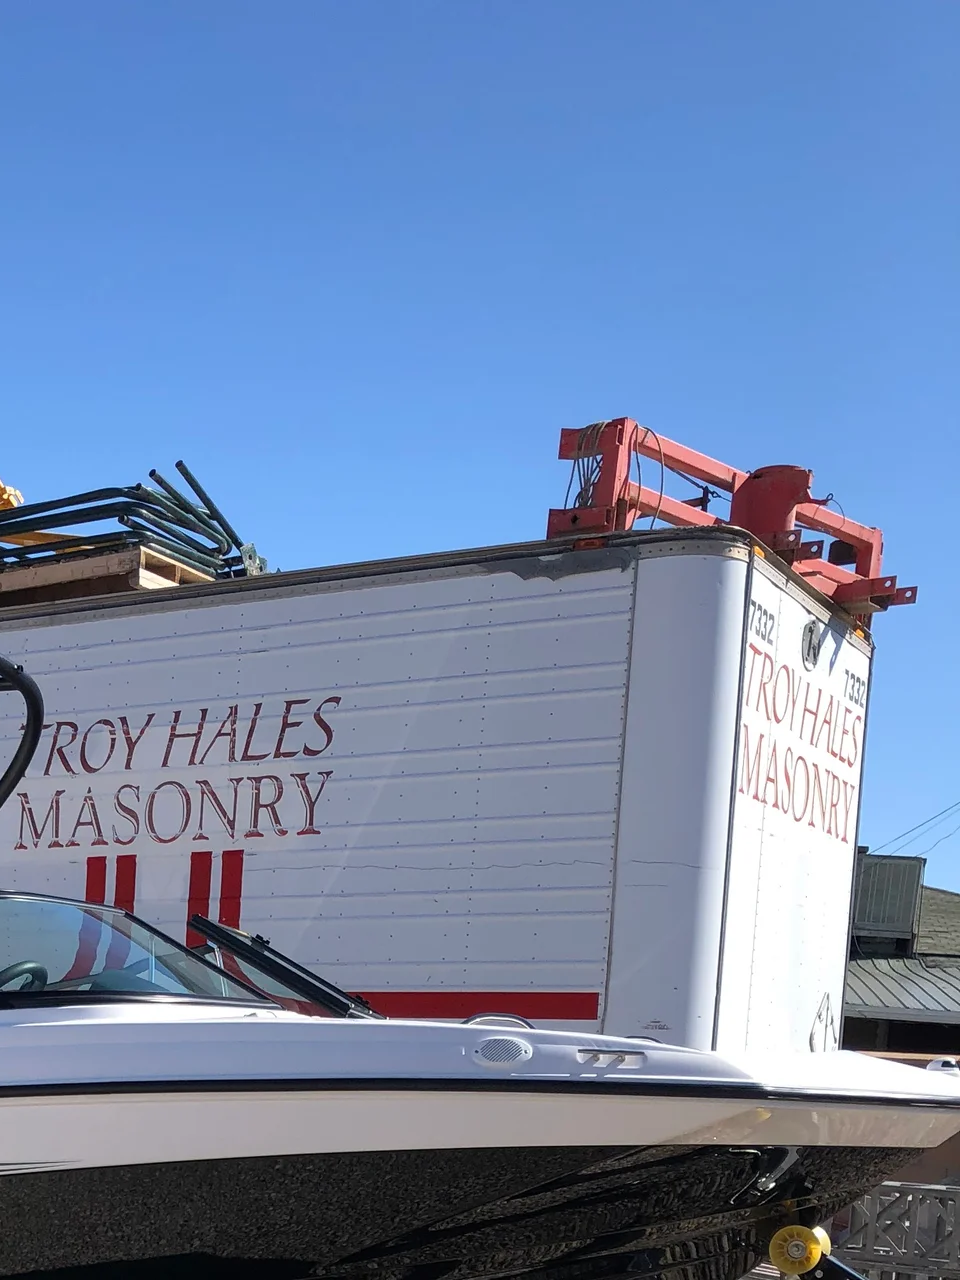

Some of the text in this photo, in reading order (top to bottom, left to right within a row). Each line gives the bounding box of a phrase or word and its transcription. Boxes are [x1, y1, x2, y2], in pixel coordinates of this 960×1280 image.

[749, 598, 775, 646] 7332
[745, 642, 862, 768] TROY HALES
[843, 668, 866, 709] 7332
[161, 696, 342, 768] HALES
[13, 770, 334, 850] MASONRY
[738, 723, 855, 843] MASONRY
